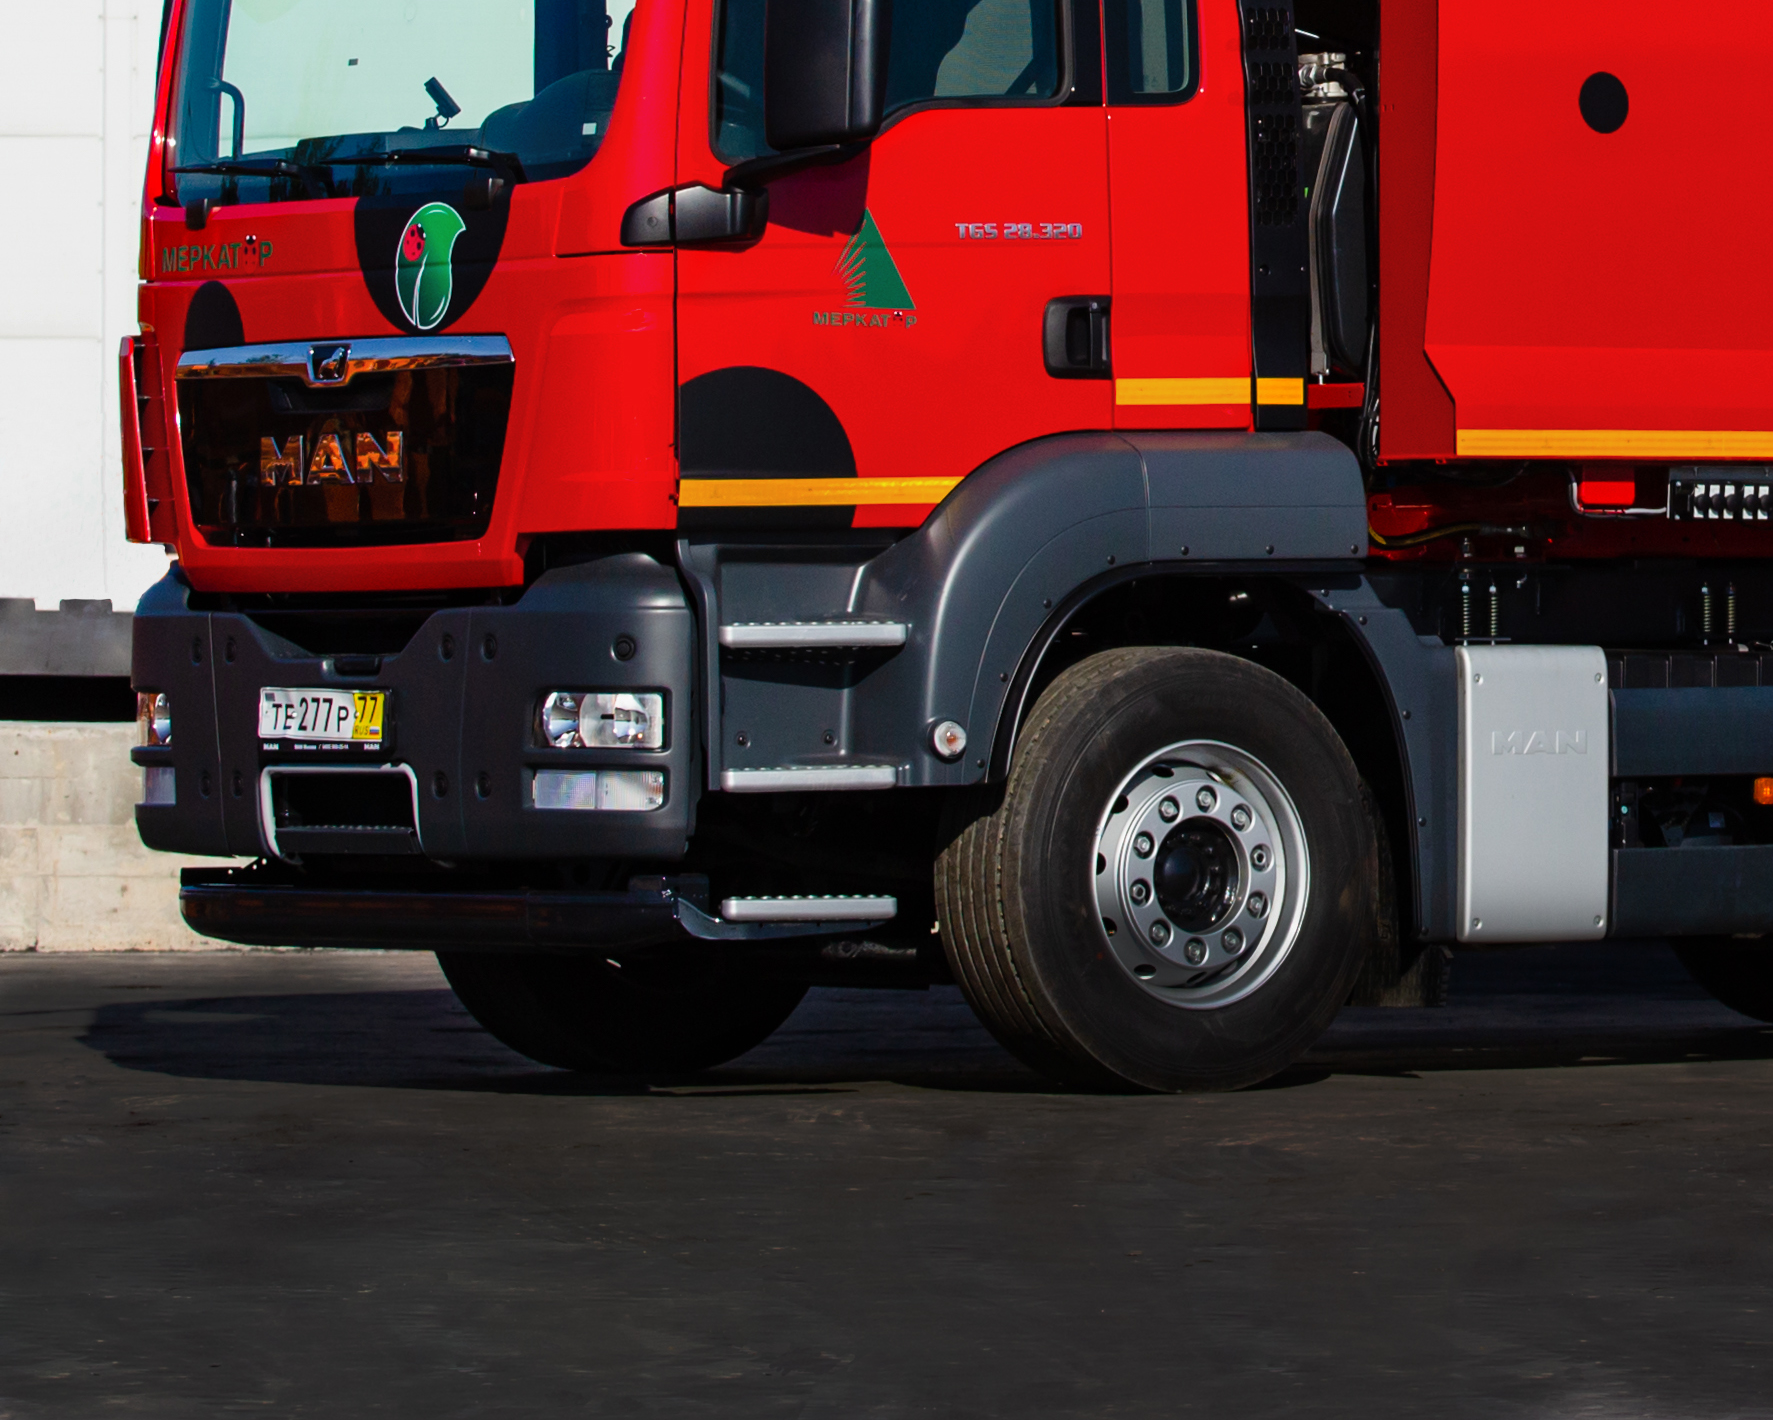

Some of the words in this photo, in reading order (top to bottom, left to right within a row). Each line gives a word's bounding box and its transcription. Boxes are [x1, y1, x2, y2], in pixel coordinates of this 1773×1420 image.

[955, 223, 998, 239] TGS
[1003, 223, 1083, 239] 28.320
[260, 431, 403, 486] MAN
[357, 696, 378, 723] 77
[354, 725, 369, 735] RUS
[1491, 730, 1587, 755] MAN
